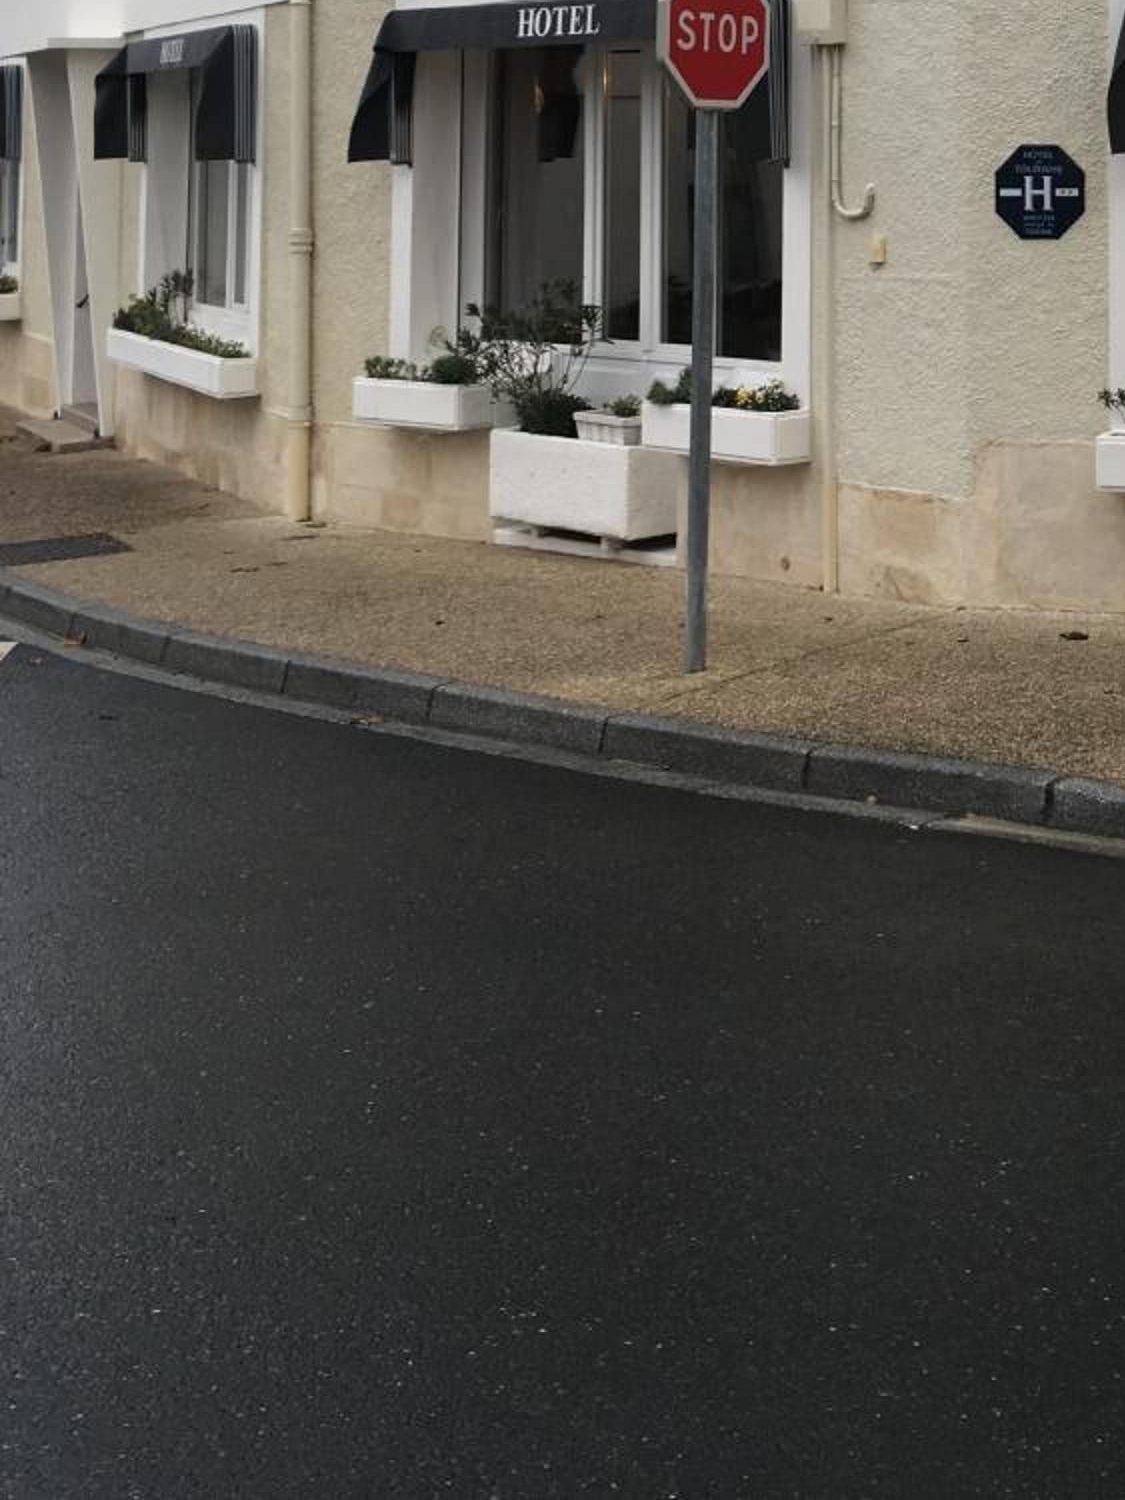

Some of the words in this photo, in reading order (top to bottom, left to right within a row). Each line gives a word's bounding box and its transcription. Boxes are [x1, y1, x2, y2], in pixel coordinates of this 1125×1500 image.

[517, 4, 600, 38] HOTEL
[677, 11, 759, 55] STOP
[1024, 175, 1054, 211] H
